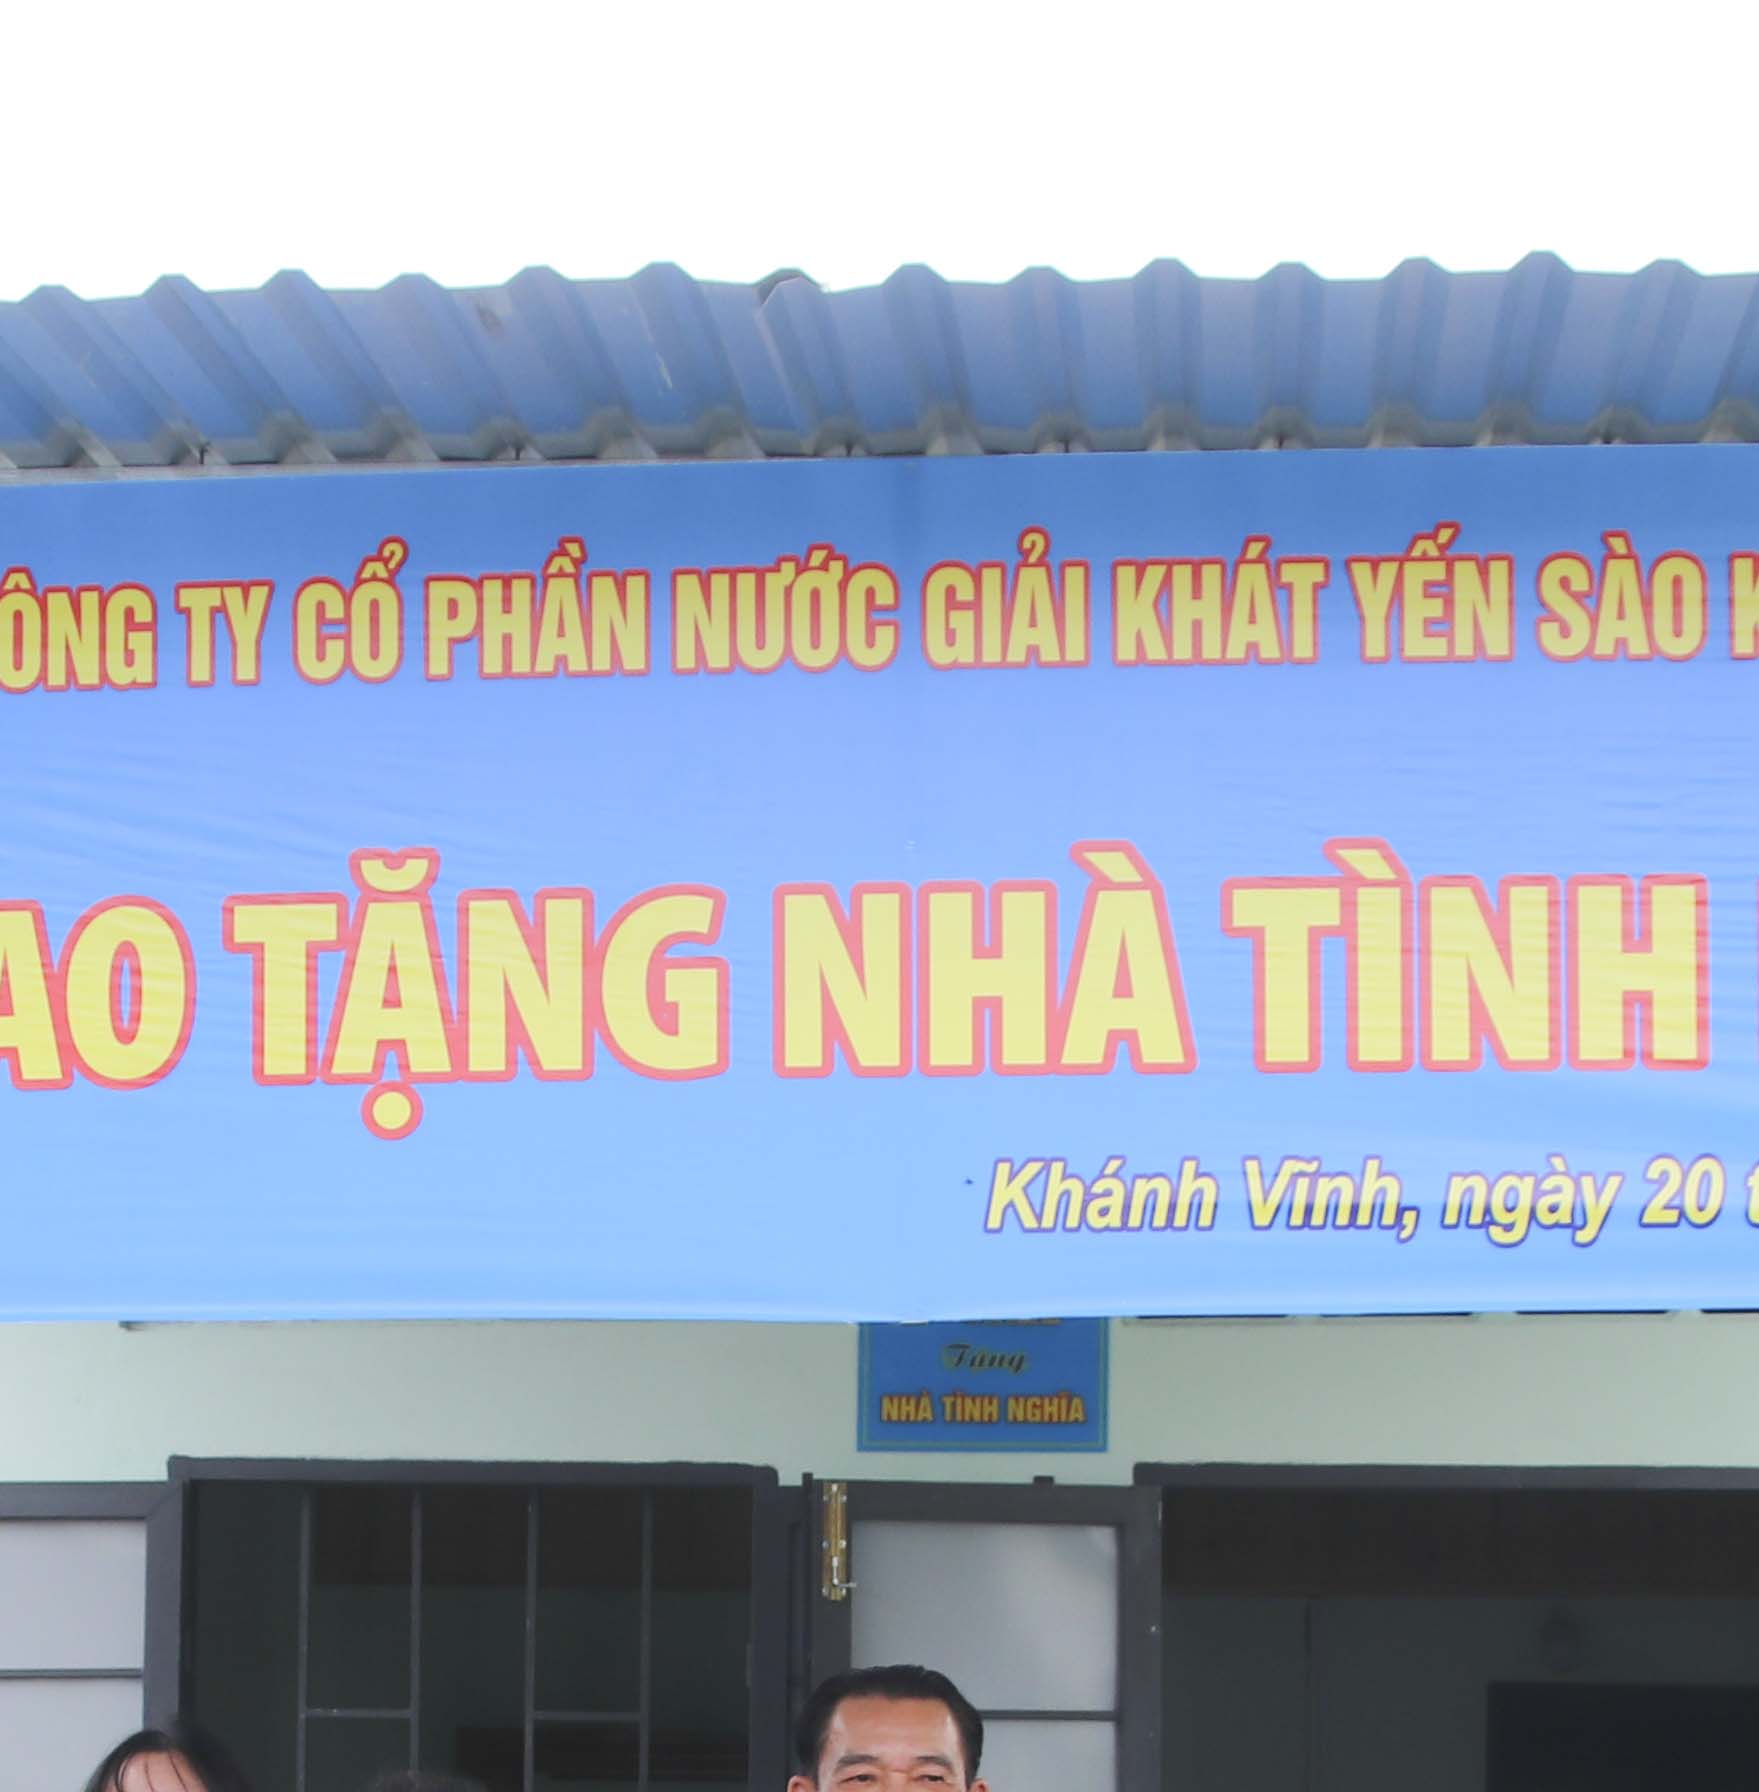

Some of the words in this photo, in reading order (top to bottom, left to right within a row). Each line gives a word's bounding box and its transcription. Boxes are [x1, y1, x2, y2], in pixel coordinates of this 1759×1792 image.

[176, 580, 273, 686] TY
[294, 537, 407, 683] CỔ
[425, 537, 650, 679] PHẦN
[672, 544, 899, 673] NƯỚC
[922, 527, 1089, 668] GIẢI
[1113, 536, 1329, 665] KHÁT
[1347, 522, 1514, 661] YẾN
[1537, 531, 1707, 660] SÀO
[222, 847, 730, 1140] TẶNG
[773, 840, 1198, 1078] NHÀ
[1221, 837, 1710, 1073] TÌNH
[985, 1156, 1218, 1236] Khánh
[1243, 1156, 1419, 1244] Vĩnh,
[1442, 1155, 1623, 1248] ngày
[1640, 1154, 1727, 1228] 20
